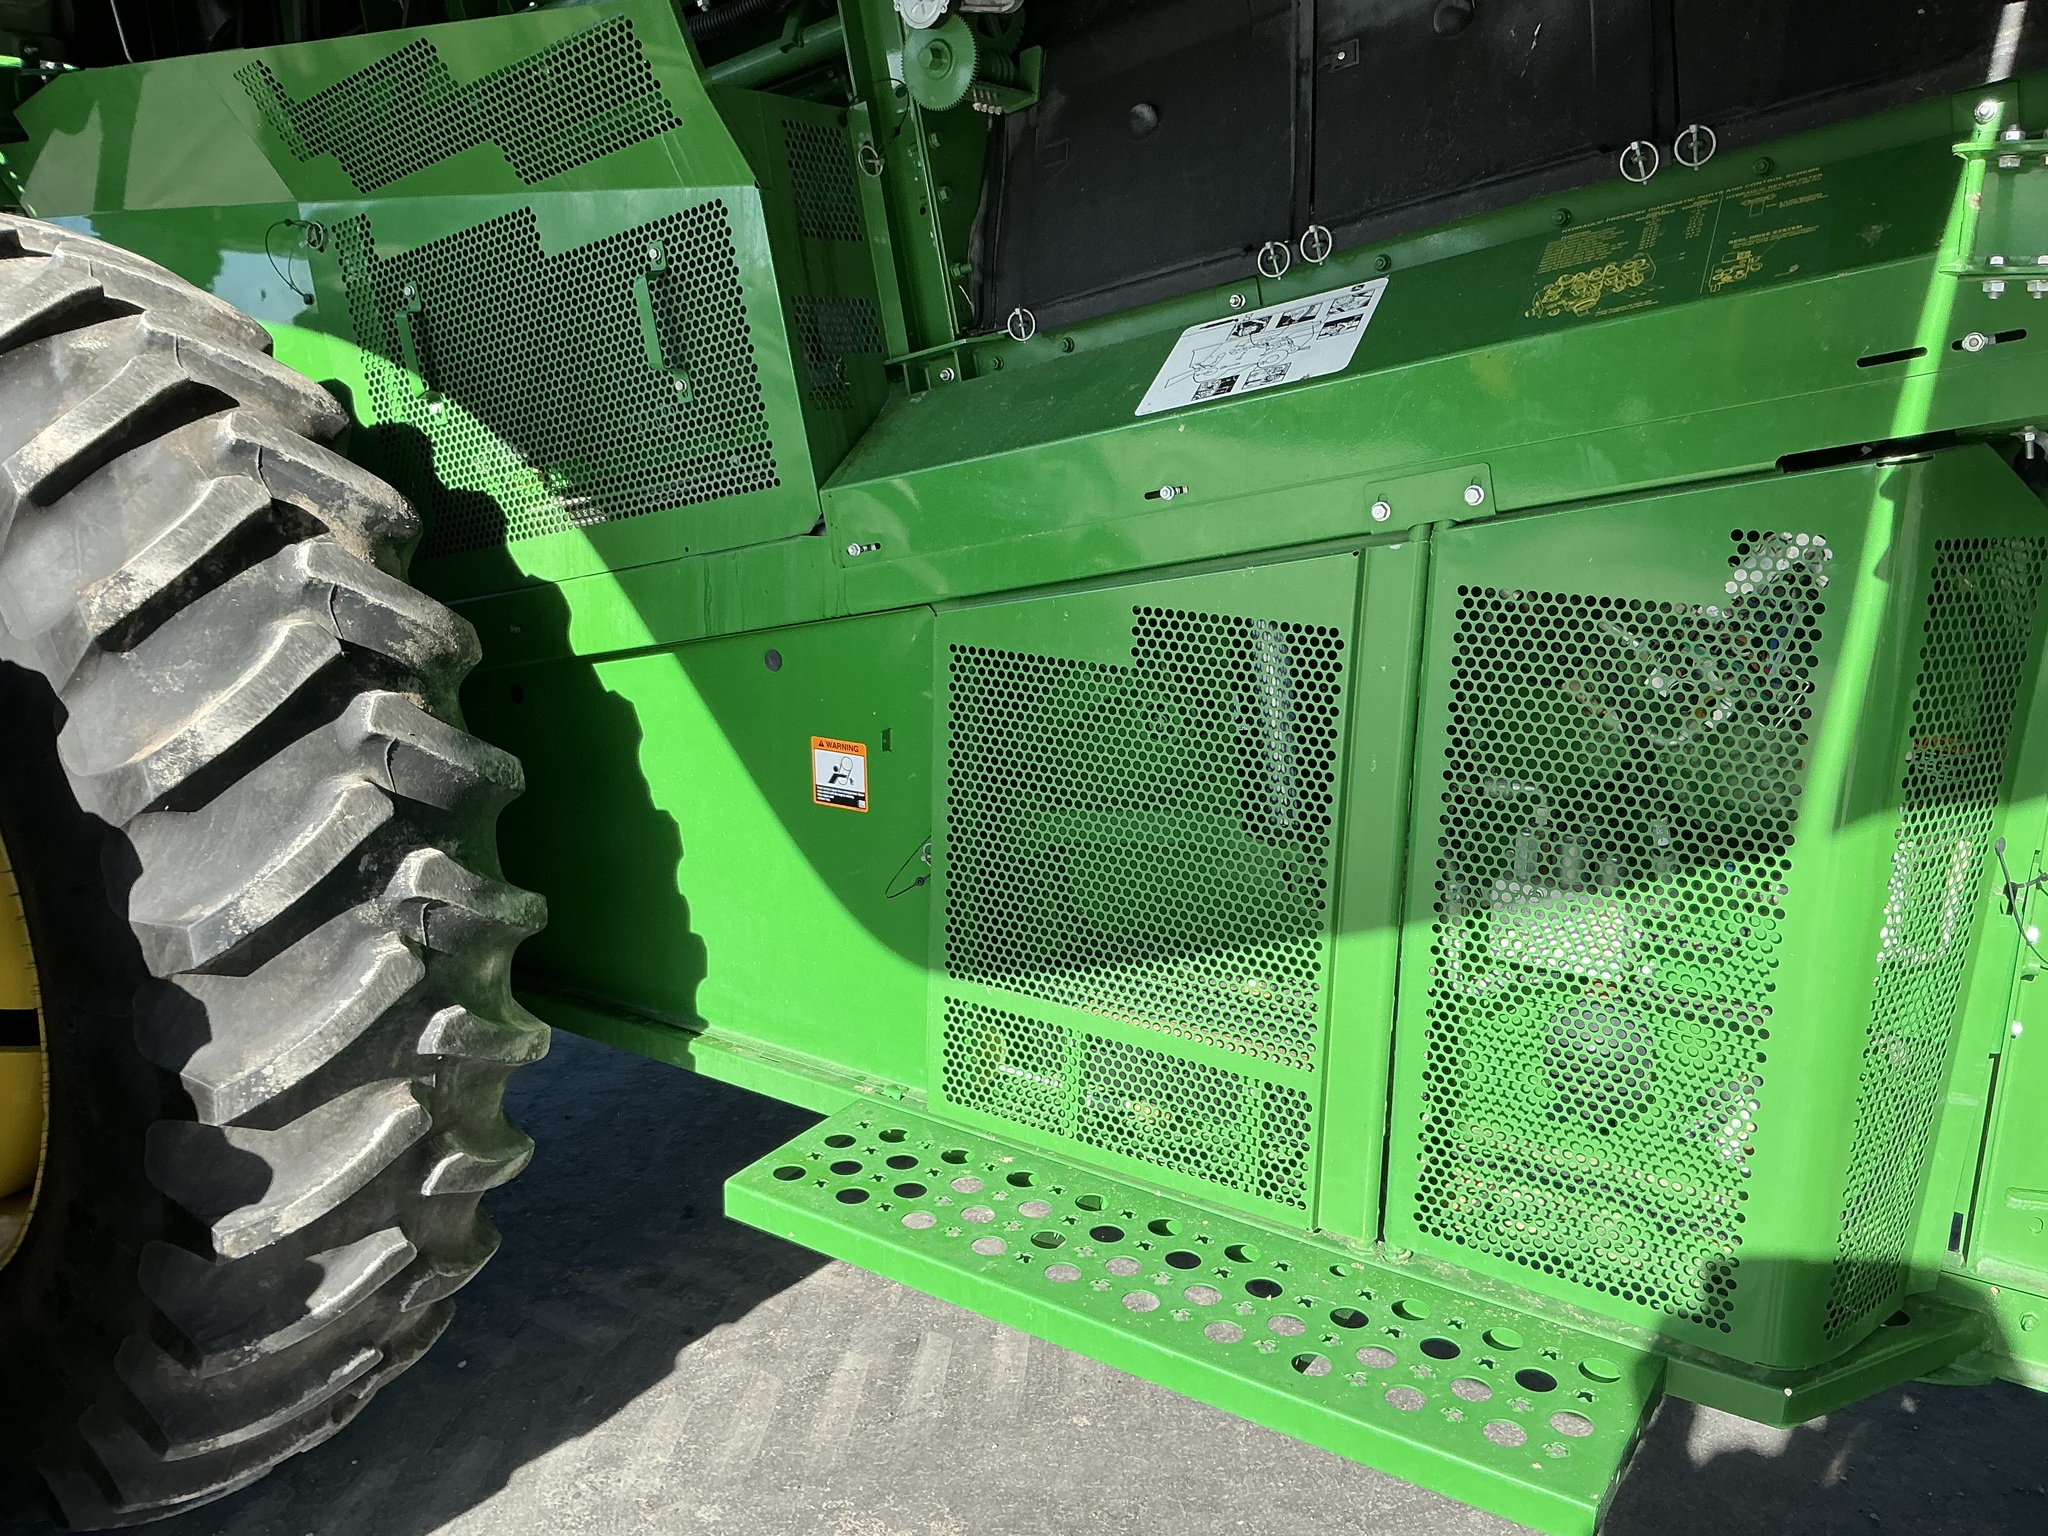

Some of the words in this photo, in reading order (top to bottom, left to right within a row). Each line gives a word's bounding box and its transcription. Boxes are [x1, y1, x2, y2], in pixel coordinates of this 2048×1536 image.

[1726, 186, 1765, 200] HYDRAULIC
[1768, 180, 1797, 190] RETURN
[1798, 173, 1823, 184] FILTER
[1561, 219, 1602, 234] HYDRAULIC
[1605, 209, 1646, 223] PRESSURE
[1648, 197, 1696, 212] DIAGNOSTIC
[1697, 190, 1724, 201] PORTS
[1726, 185, 1743, 193] AND
[1744, 175, 1783, 189] CONTROL
[1728, 237, 1748, 245] REEL
[1749, 231, 1771, 240] DRIVE
[1772, 224, 1803, 235] SYSTEM
[825, 740, 859, 752] WARNING
